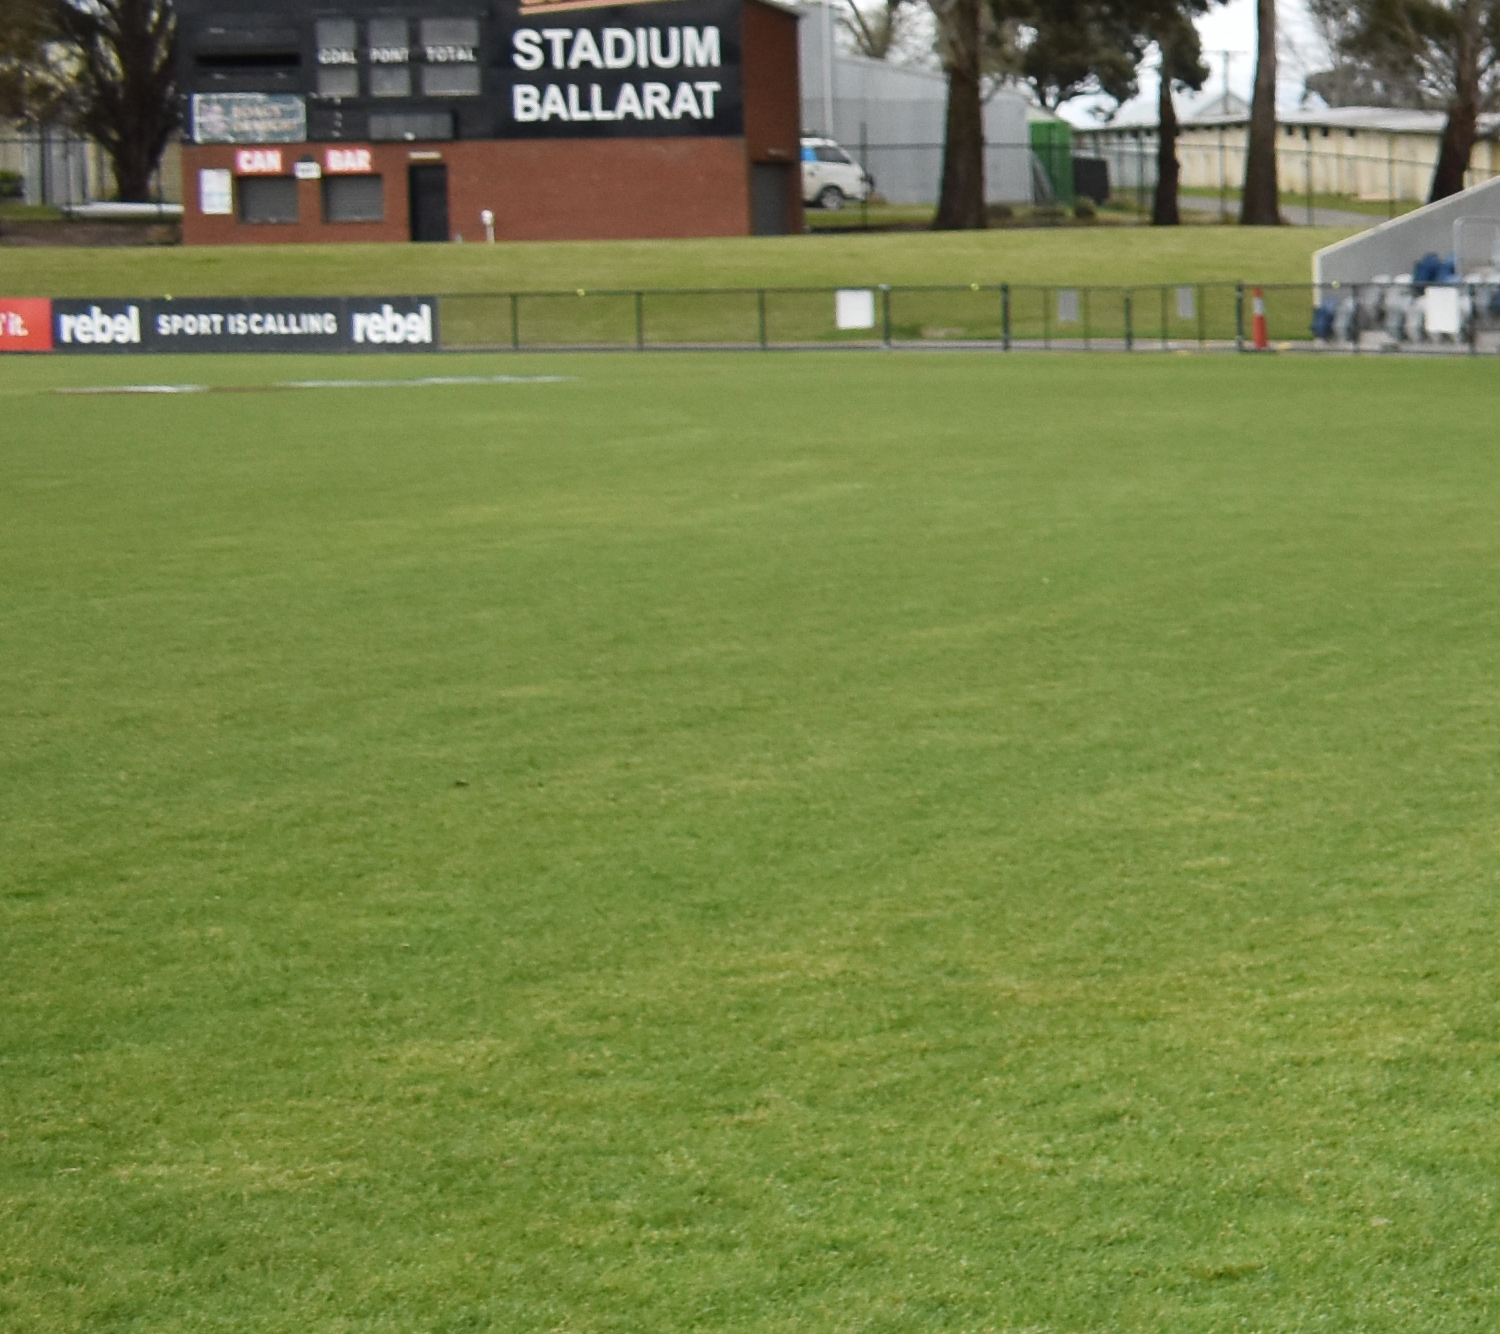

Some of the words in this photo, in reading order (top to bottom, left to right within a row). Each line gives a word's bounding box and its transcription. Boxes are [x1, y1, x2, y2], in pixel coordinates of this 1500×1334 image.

[426, 46, 477, 62] TOTAL
[512, 25, 721, 70] STADIUM
[512, 81, 721, 121] BALLARAT
[60, 305, 141, 343] rebel
[157, 314, 224, 335] SPORT
[352, 304, 432, 343] rebel
